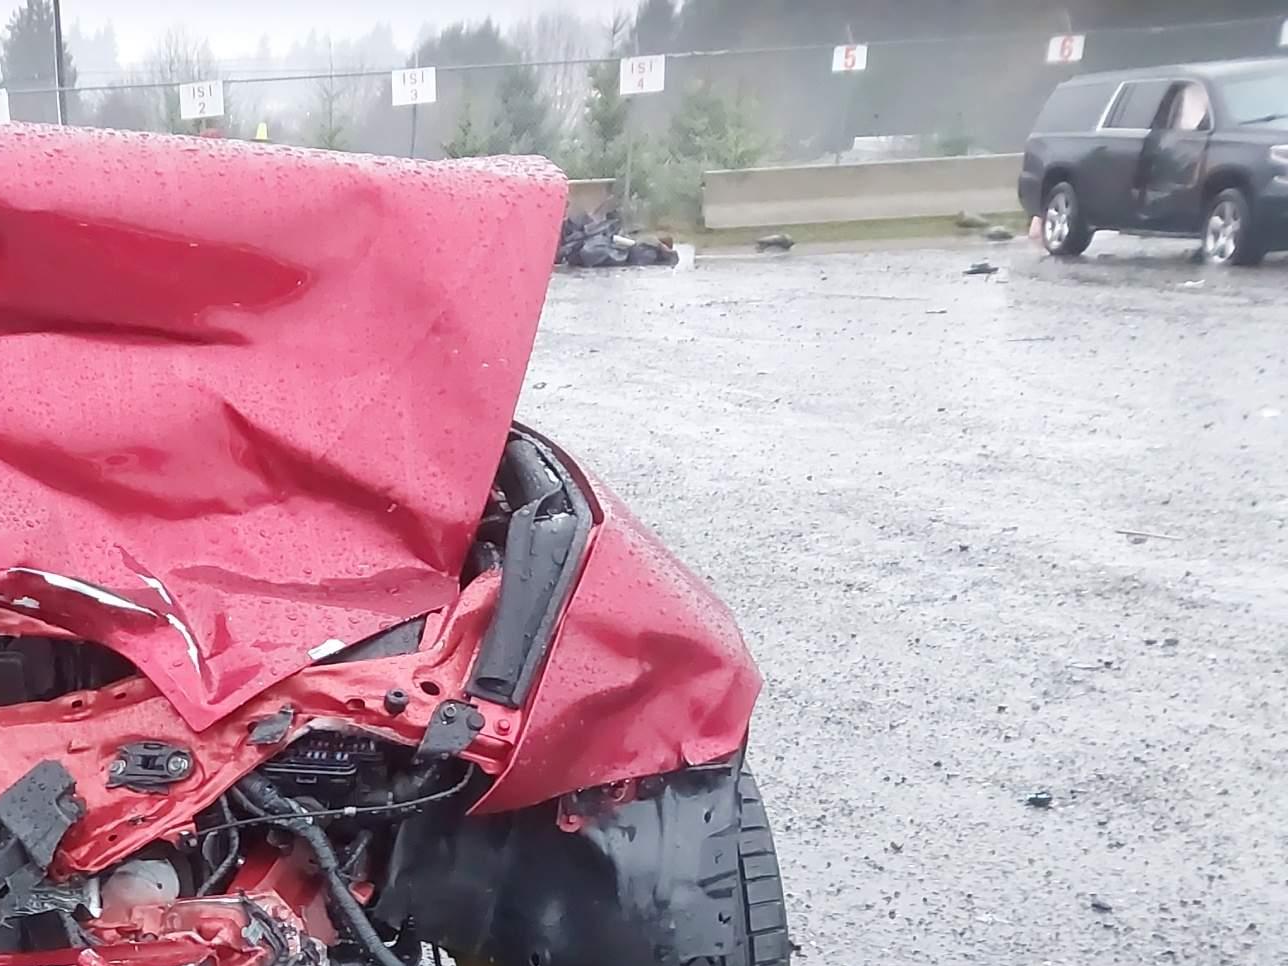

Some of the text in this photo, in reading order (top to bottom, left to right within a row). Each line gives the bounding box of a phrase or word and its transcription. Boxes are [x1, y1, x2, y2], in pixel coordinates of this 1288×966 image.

[1060, 36, 1073, 61] 6
[844, 46, 857, 69] 5
[638, 78, 646, 89] 4
[410, 88, 418, 102] 3
[198, 101, 206, 115] 2
